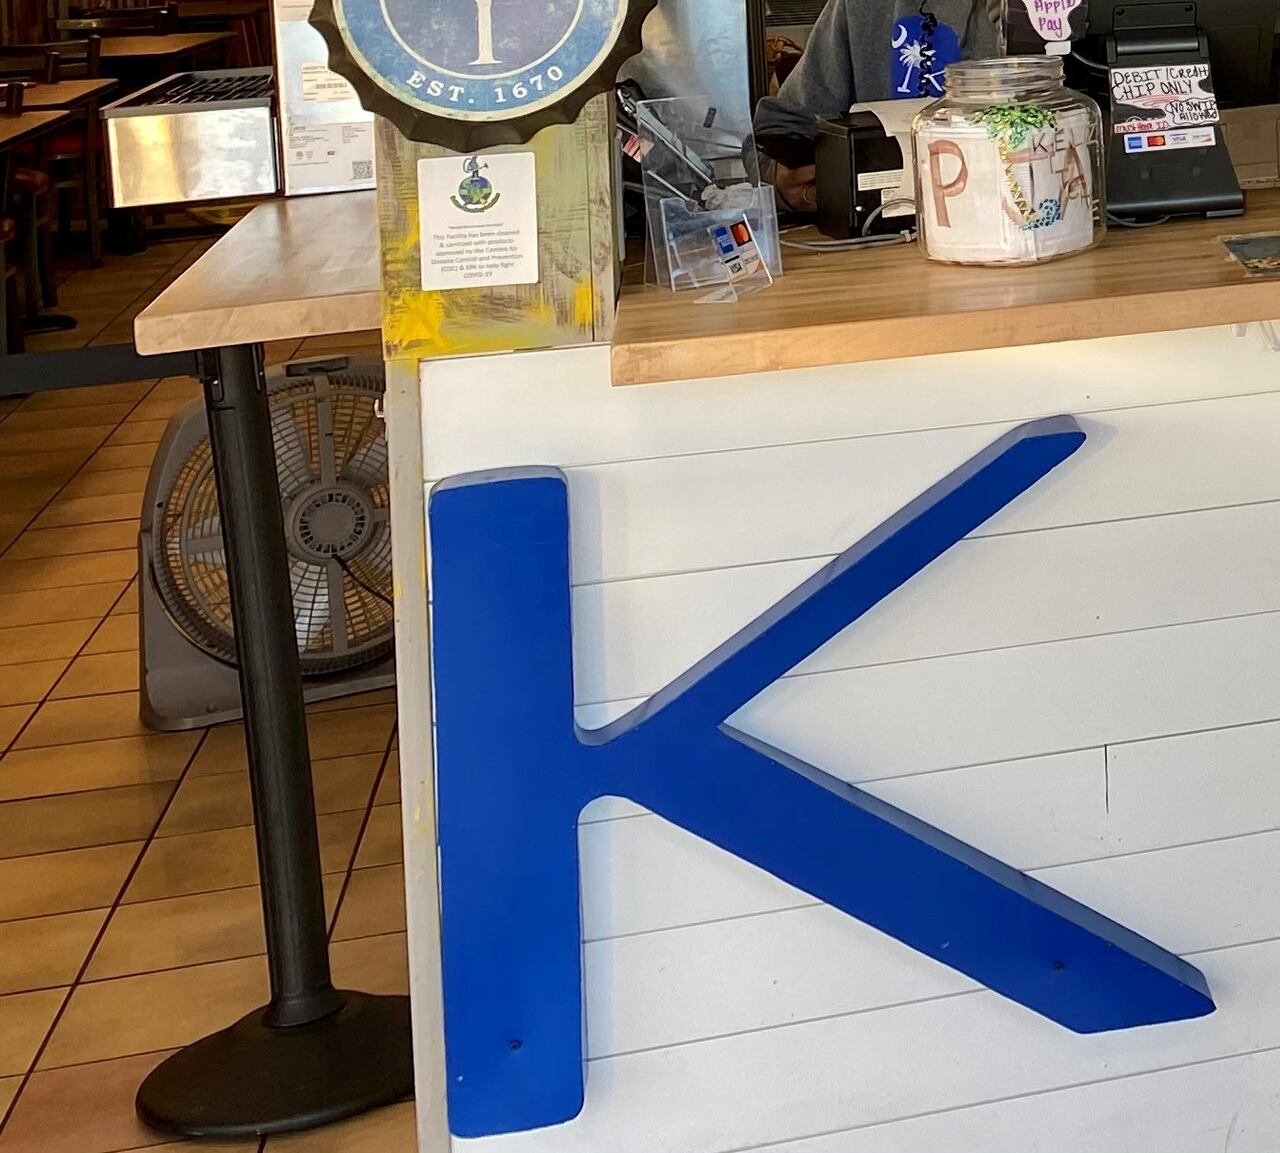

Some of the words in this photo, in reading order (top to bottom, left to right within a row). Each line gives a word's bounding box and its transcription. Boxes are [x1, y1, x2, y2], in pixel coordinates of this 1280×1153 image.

[1039, 16, 1062, 37] Pay
[406, 70, 475, 103] EST.
[495, 65, 563, 104] 1670
[1112, 82, 1155, 100] CHIP
[1160, 79, 1192, 96] ONLY
